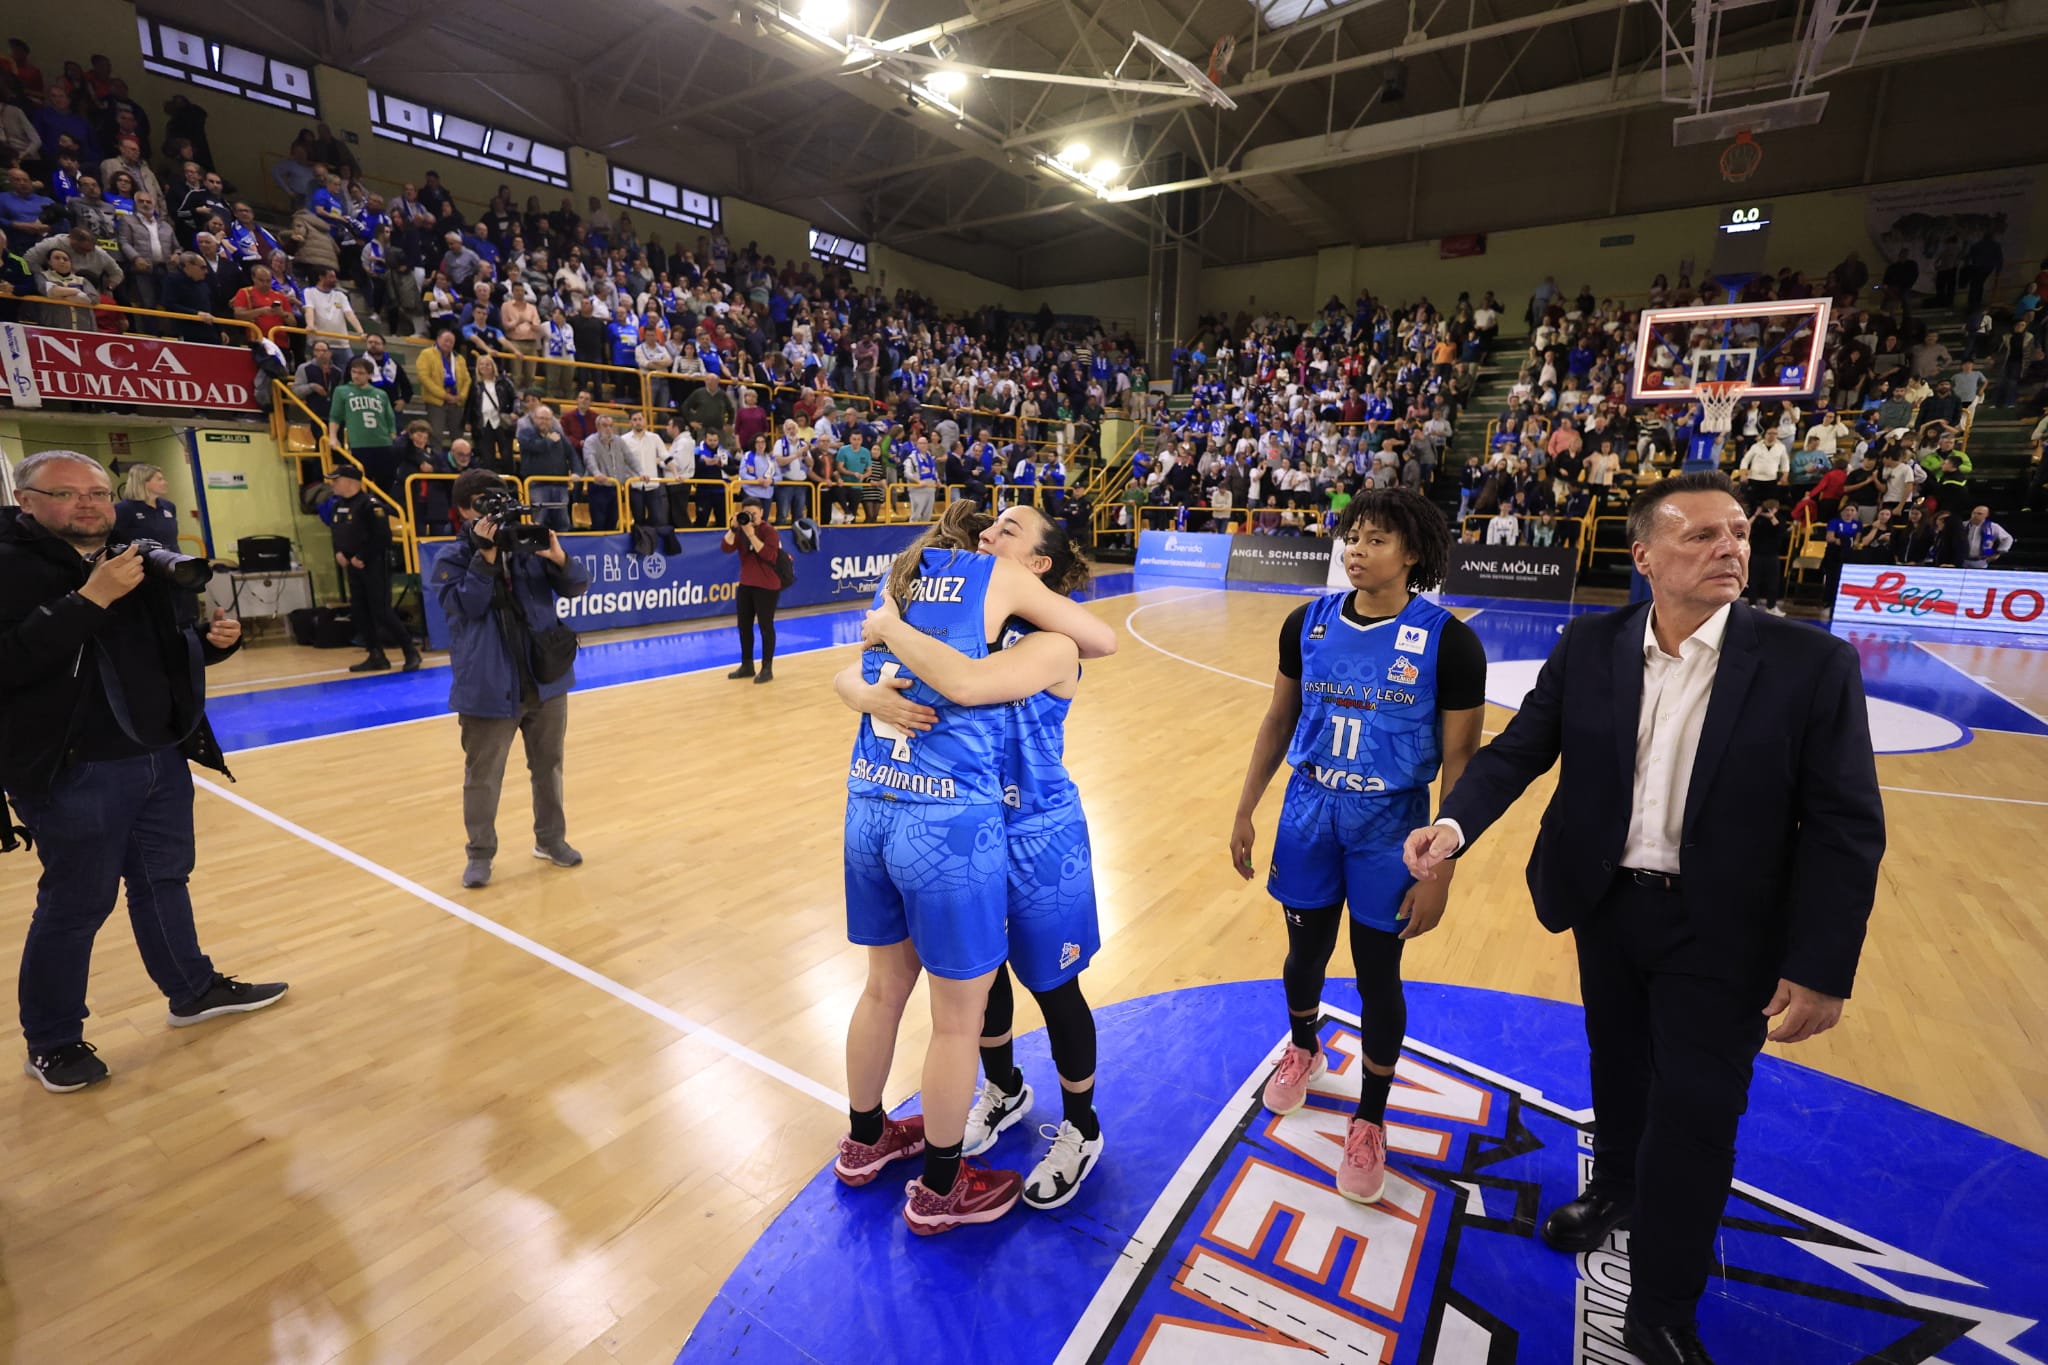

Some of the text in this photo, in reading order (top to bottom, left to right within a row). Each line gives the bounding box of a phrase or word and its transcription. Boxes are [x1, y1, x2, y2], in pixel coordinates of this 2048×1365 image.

[1732, 207, 1760, 223] 0.0
[349, 395, 383, 413] CELTICS
[362, 411, 377, 428] 5
[1231, 548, 1330, 561] ANGEL SCHLESSER
[1460, 560, 1560, 576] ANNE MÖLLER
[1965, 588, 2045, 622] JO
[1304, 681, 1416, 705] CASTILLA Y LEÓN
[1331, 715, 1361, 760] 11
